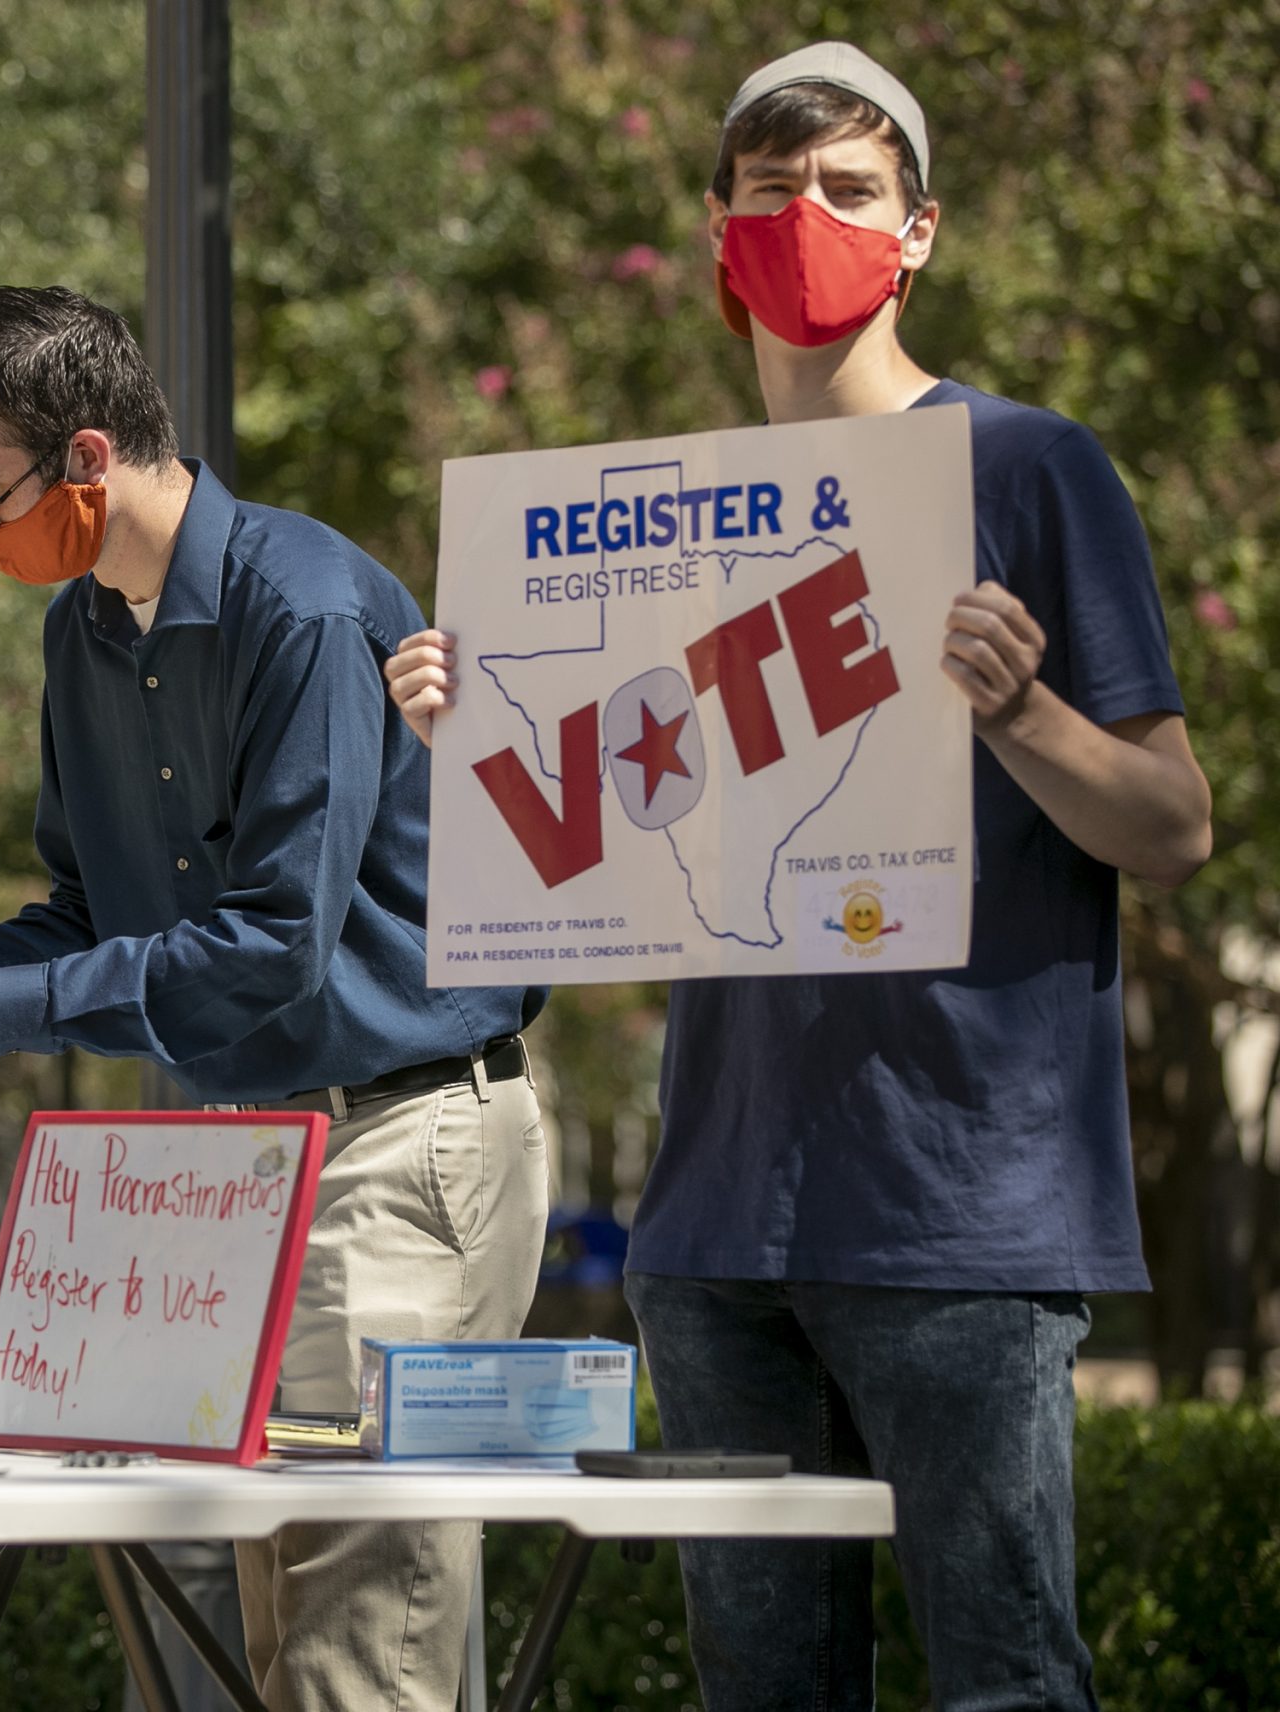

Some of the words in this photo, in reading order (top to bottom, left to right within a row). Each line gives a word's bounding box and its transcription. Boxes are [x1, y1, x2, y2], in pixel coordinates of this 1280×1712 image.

[525, 482, 783, 559] REGISTER
[810, 475, 851, 530] &
[526, 561, 700, 605] REGISTRESE
[719, 556, 737, 584] Y
[471, 548, 901, 890] VOTE
[786, 855, 842, 874] TRAVIS
[847, 854, 874, 871] CO.
[878, 851, 908, 868] TAX
[913, 847, 957, 866] OFFICE
[447, 924, 472, 935] FOR
[479, 922, 544, 934] RESIDENTS
[547, 920, 563, 931] OF
[566, 918, 605, 930] TRAVIS
[608, 917, 628, 928] CO.
[446, 950, 478, 962] PARA
[483, 948, 555, 961] RESIDENTES
[558, 947, 579, 959] DEL
[583, 945, 634, 958] CONDADO
[637, 944, 649, 955] DE
[652, 943, 684, 954] TRAVIS
[31, 1131, 79, 1243] Hey
[11, 1228, 108, 1332] Register
[119, 1256, 144, 1317] to
[402, 1385, 472, 1398] Disposable
[474, 1385, 508, 1396] mask
